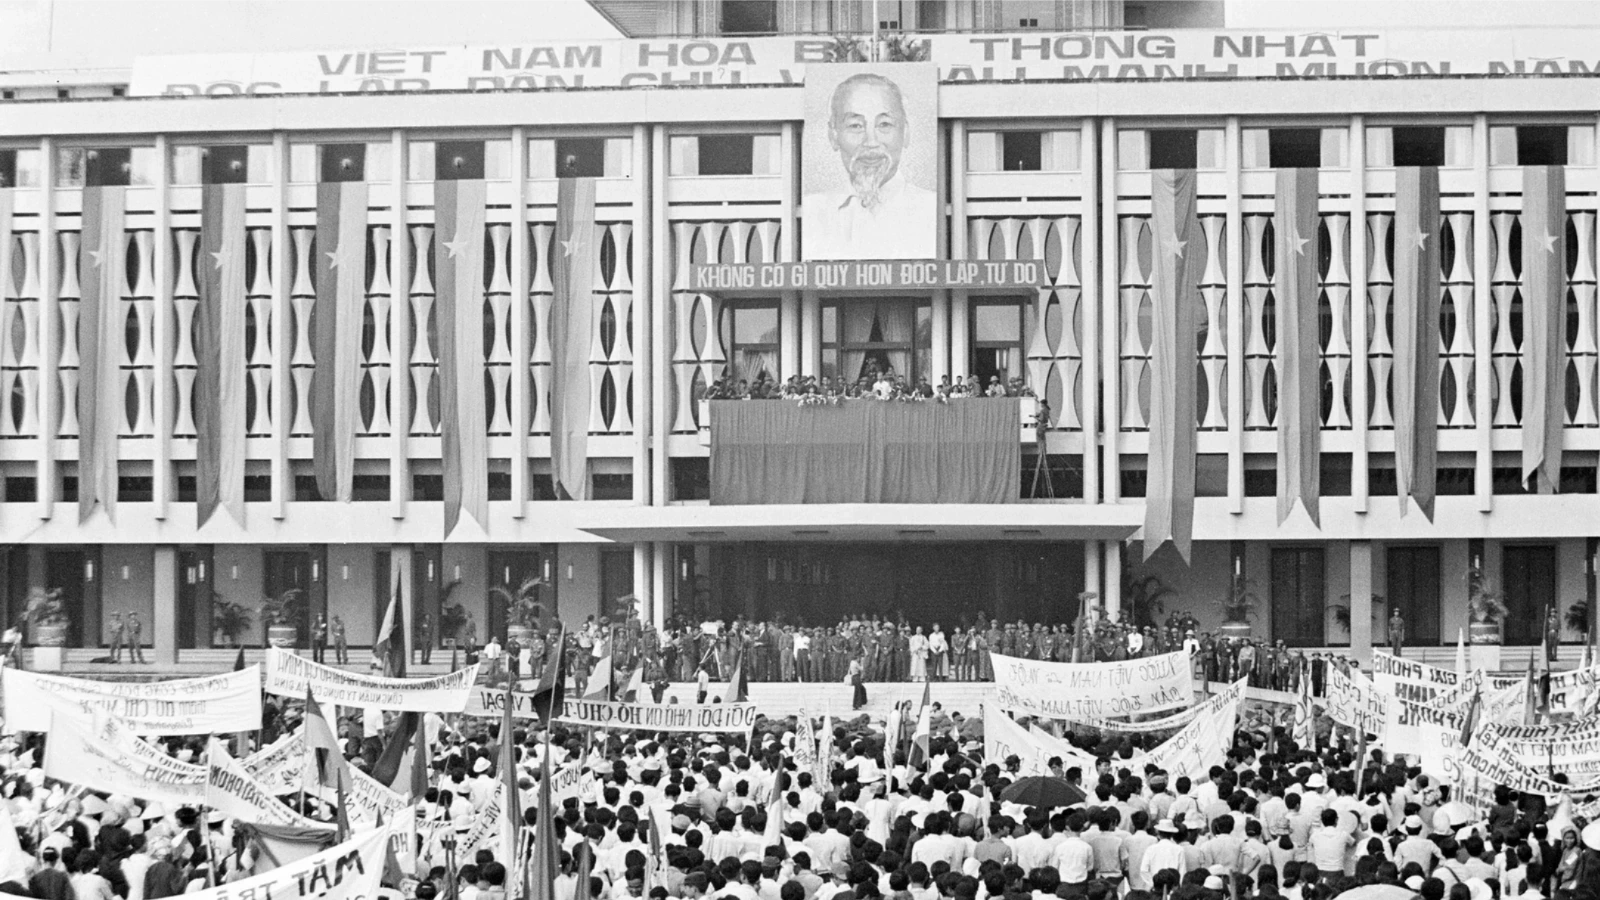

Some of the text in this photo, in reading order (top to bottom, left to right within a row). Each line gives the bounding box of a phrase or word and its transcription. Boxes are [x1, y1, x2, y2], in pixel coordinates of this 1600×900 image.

[483, 45, 602, 71] NAM
[697, 263, 755, 288] KHÔNG
[761, 263, 784, 287] CÓ
[791, 263, 808, 287] GÌ
[900, 261, 937, 287] ĐỘC
[1013, 263, 1037, 284] DO
